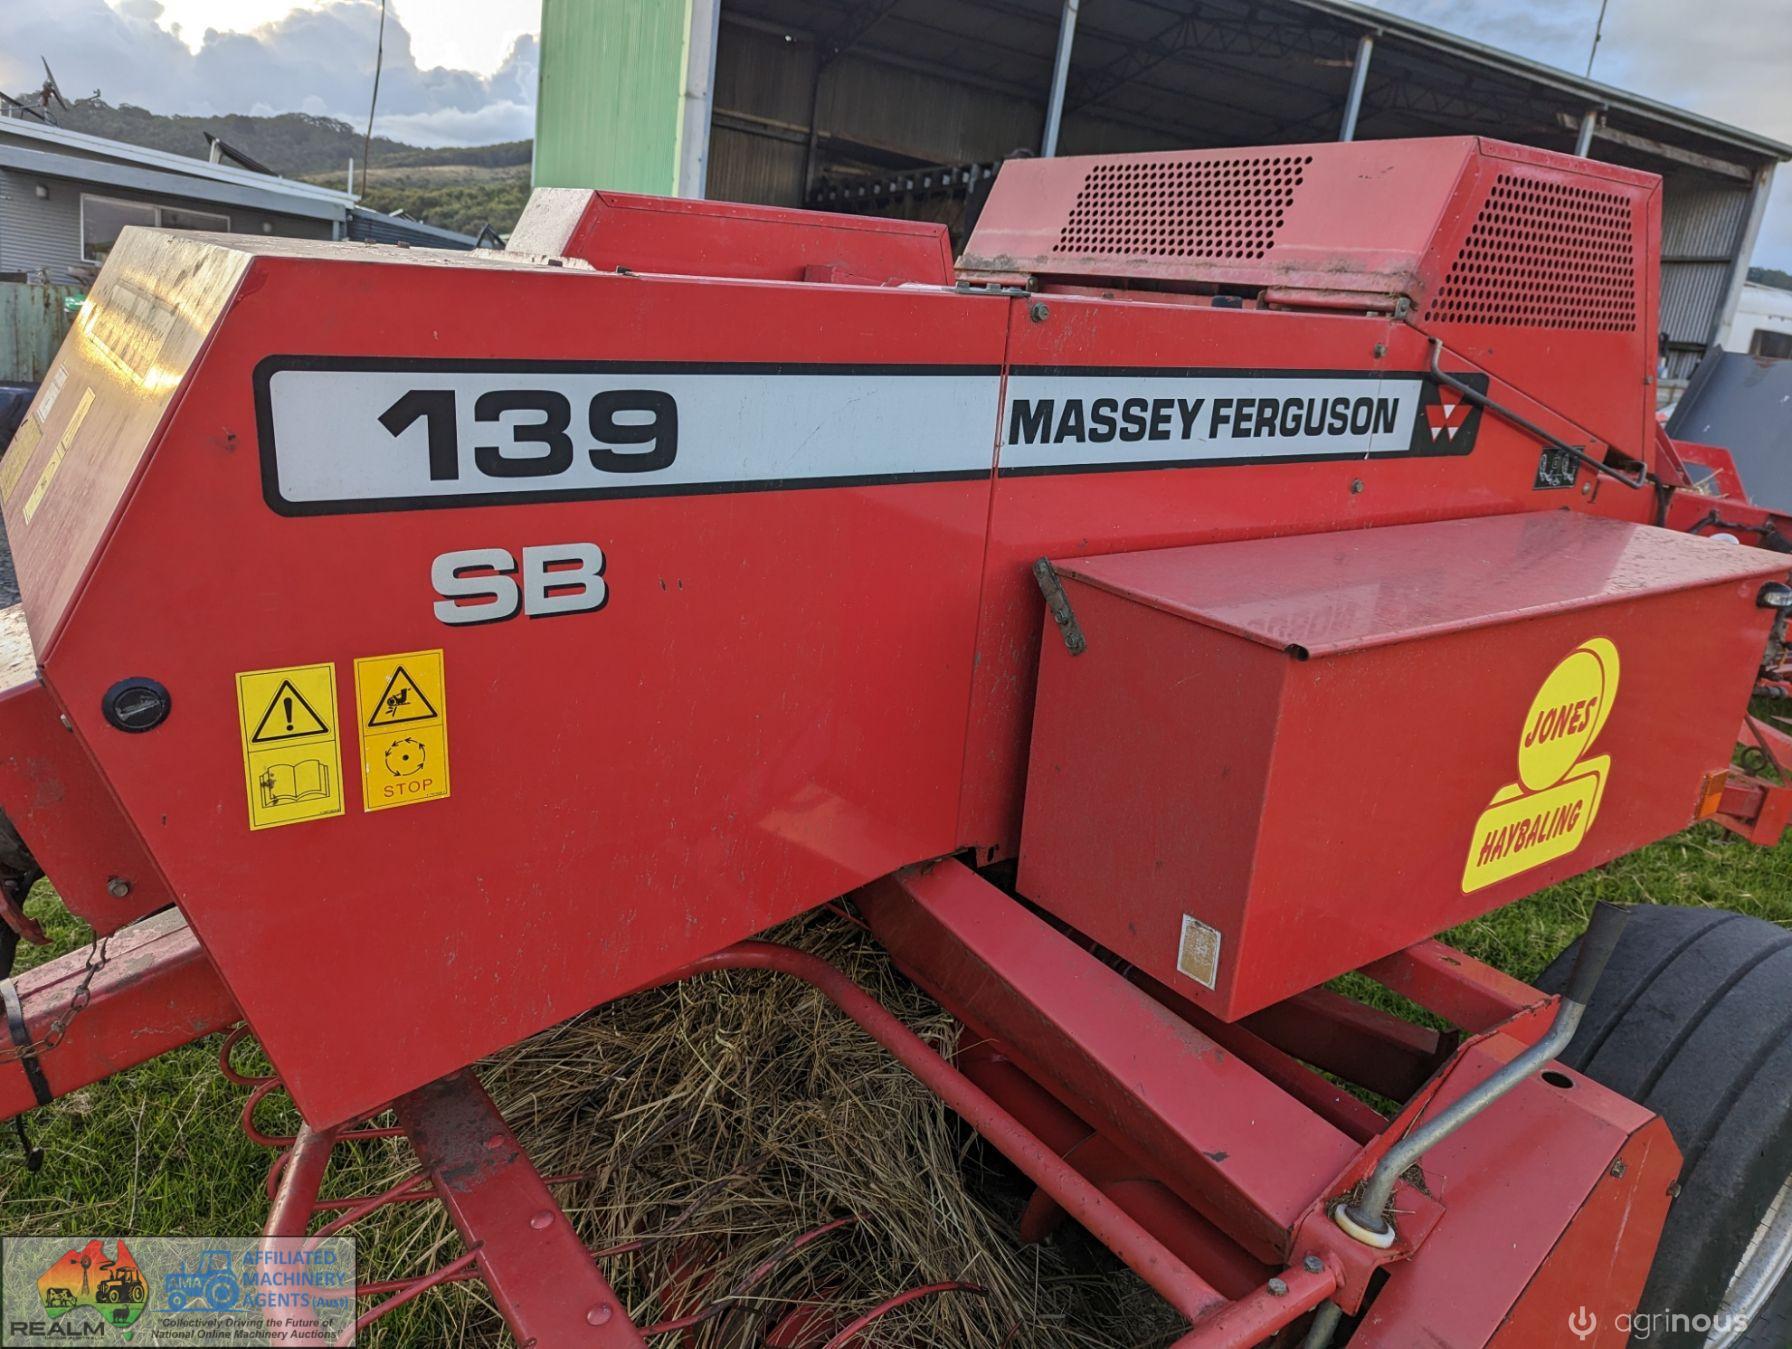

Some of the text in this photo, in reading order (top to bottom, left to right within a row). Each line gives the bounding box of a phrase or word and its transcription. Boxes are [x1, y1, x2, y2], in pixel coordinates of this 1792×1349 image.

[377, 389, 679, 481] 139
[1008, 397, 1400, 446] MASSEY FERGUSON
[431, 542, 609, 627] SB
[1524, 696, 1598, 748] JONES
[383, 778, 433, 798] STOP
[1476, 799, 1584, 867] HAYBALING
